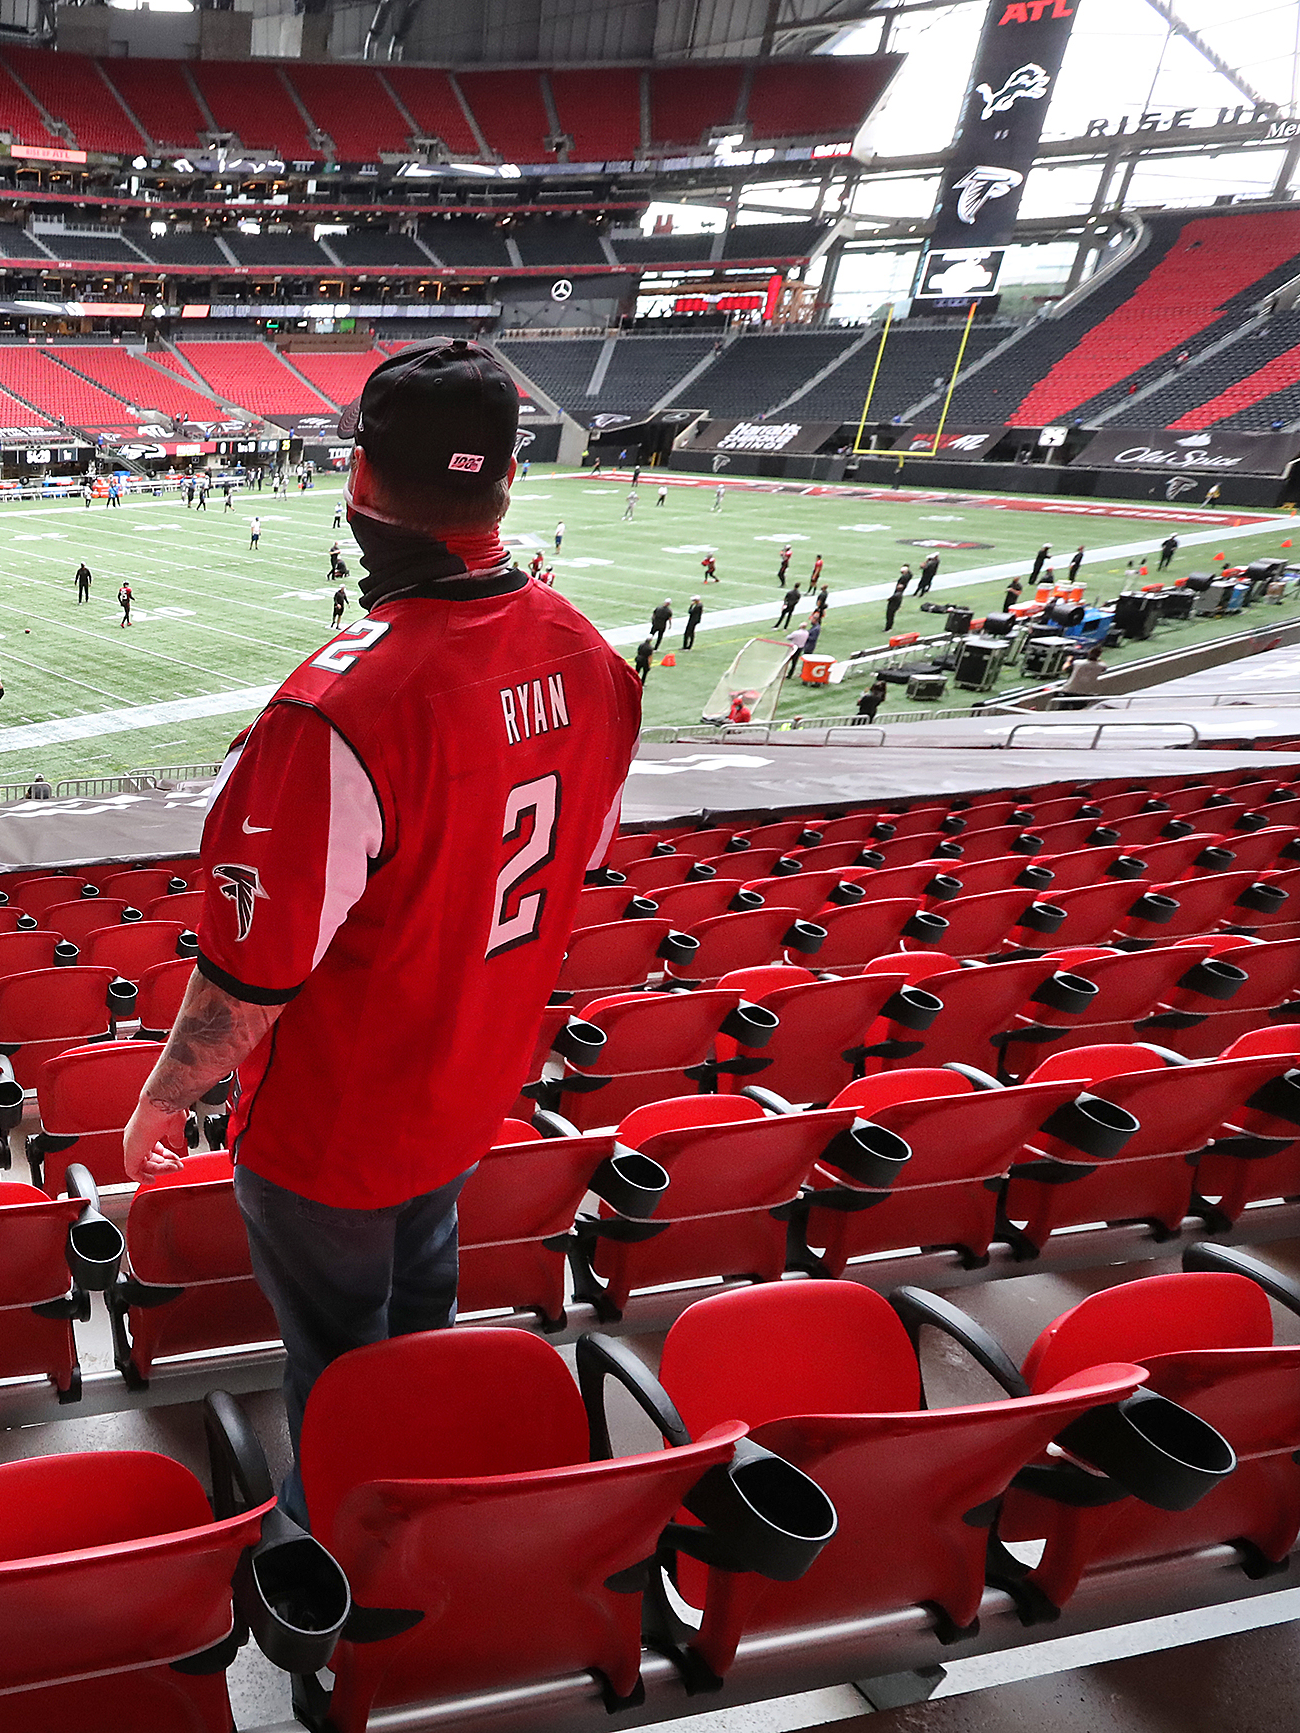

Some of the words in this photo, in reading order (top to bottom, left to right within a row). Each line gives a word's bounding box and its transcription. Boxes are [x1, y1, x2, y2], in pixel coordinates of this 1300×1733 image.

[998, 0, 1074, 26] ATL
[730, 422, 802, 436] Harrah's
[717, 440, 787, 450] CASINOS
[1114, 446, 1168, 463] Old
[1165, 450, 1250, 467] Spice
[308, 617, 393, 676] 2
[812, 664, 827, 678] G
[500, 671, 571, 747] RYAN
[484, 769, 563, 965] 2
